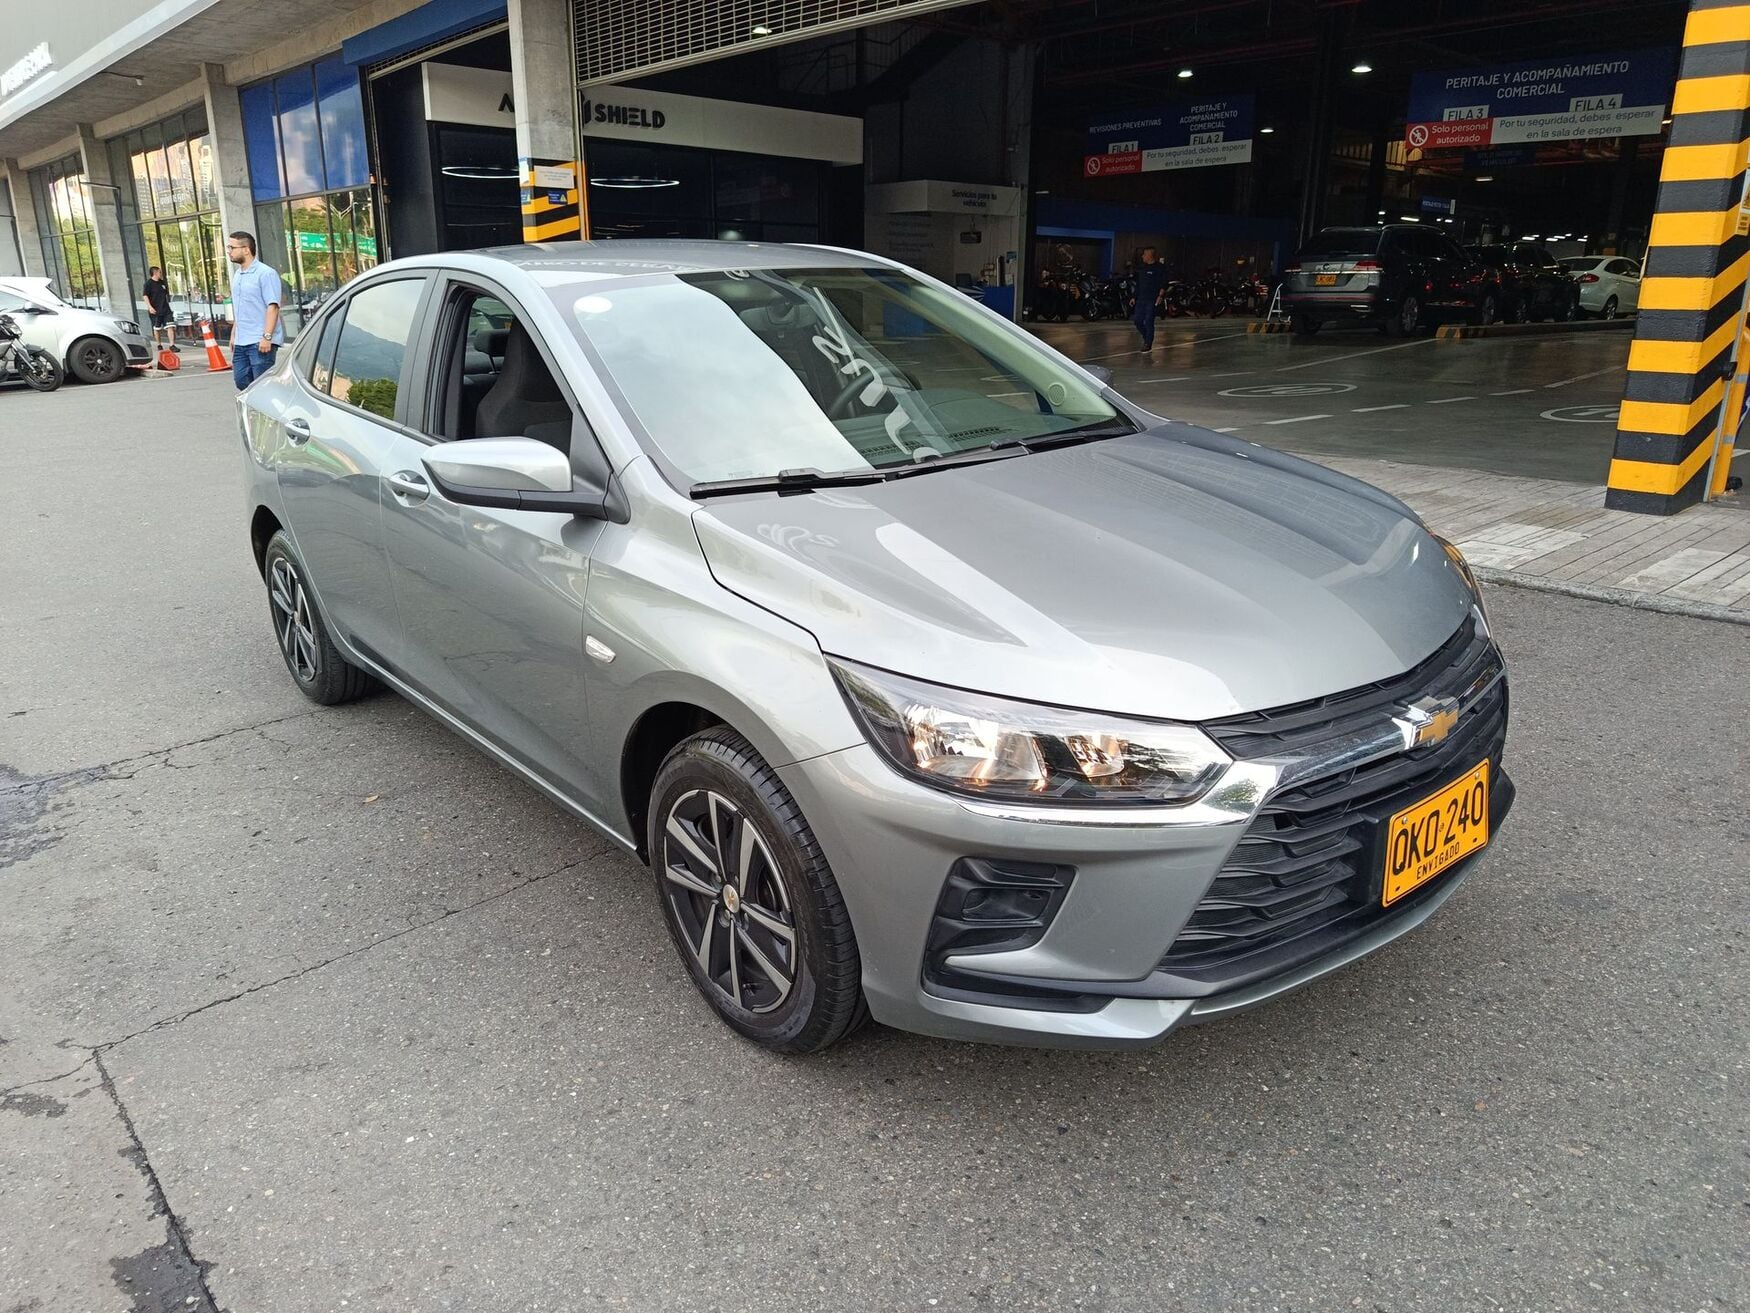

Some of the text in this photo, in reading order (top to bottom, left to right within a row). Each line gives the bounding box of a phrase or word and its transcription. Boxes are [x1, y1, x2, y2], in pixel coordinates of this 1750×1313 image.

[1445, 60, 1630, 90] PERITAJE Y ACOMPAÑAMIENTO
[1496, 82, 1567, 99] COMERCIAL
[1190, 101, 1228, 114] PERITAJE Y
[1574, 97, 1617, 111] FILA 4
[594, 103, 666, 129] SHIELD
[1179, 109, 1239, 125] ACOMPAÑAMIENTO
[1448, 108, 1484, 121] FILA 3
[1499, 109, 1656, 129] Por tu seguridad, debes esperar
[1089, 117, 1163, 134] REVISIONES PREVENTIVAS
[1189, 120, 1227, 132] COMERCIAL
[1431, 122, 1489, 134] Solo personal
[1526, 125, 1623, 139] en la sala de espera
[1193, 133, 1220, 145] FILA 2
[1436, 133, 1481, 144] autorizado
[1112, 143, 1130, 153] FILA
[1147, 151, 1157, 159] Por
[1198, 144, 1219, 154] debes
[1221, 143, 1247, 154] esperar
[1416, 841, 1460, 880] ENVIGADO
